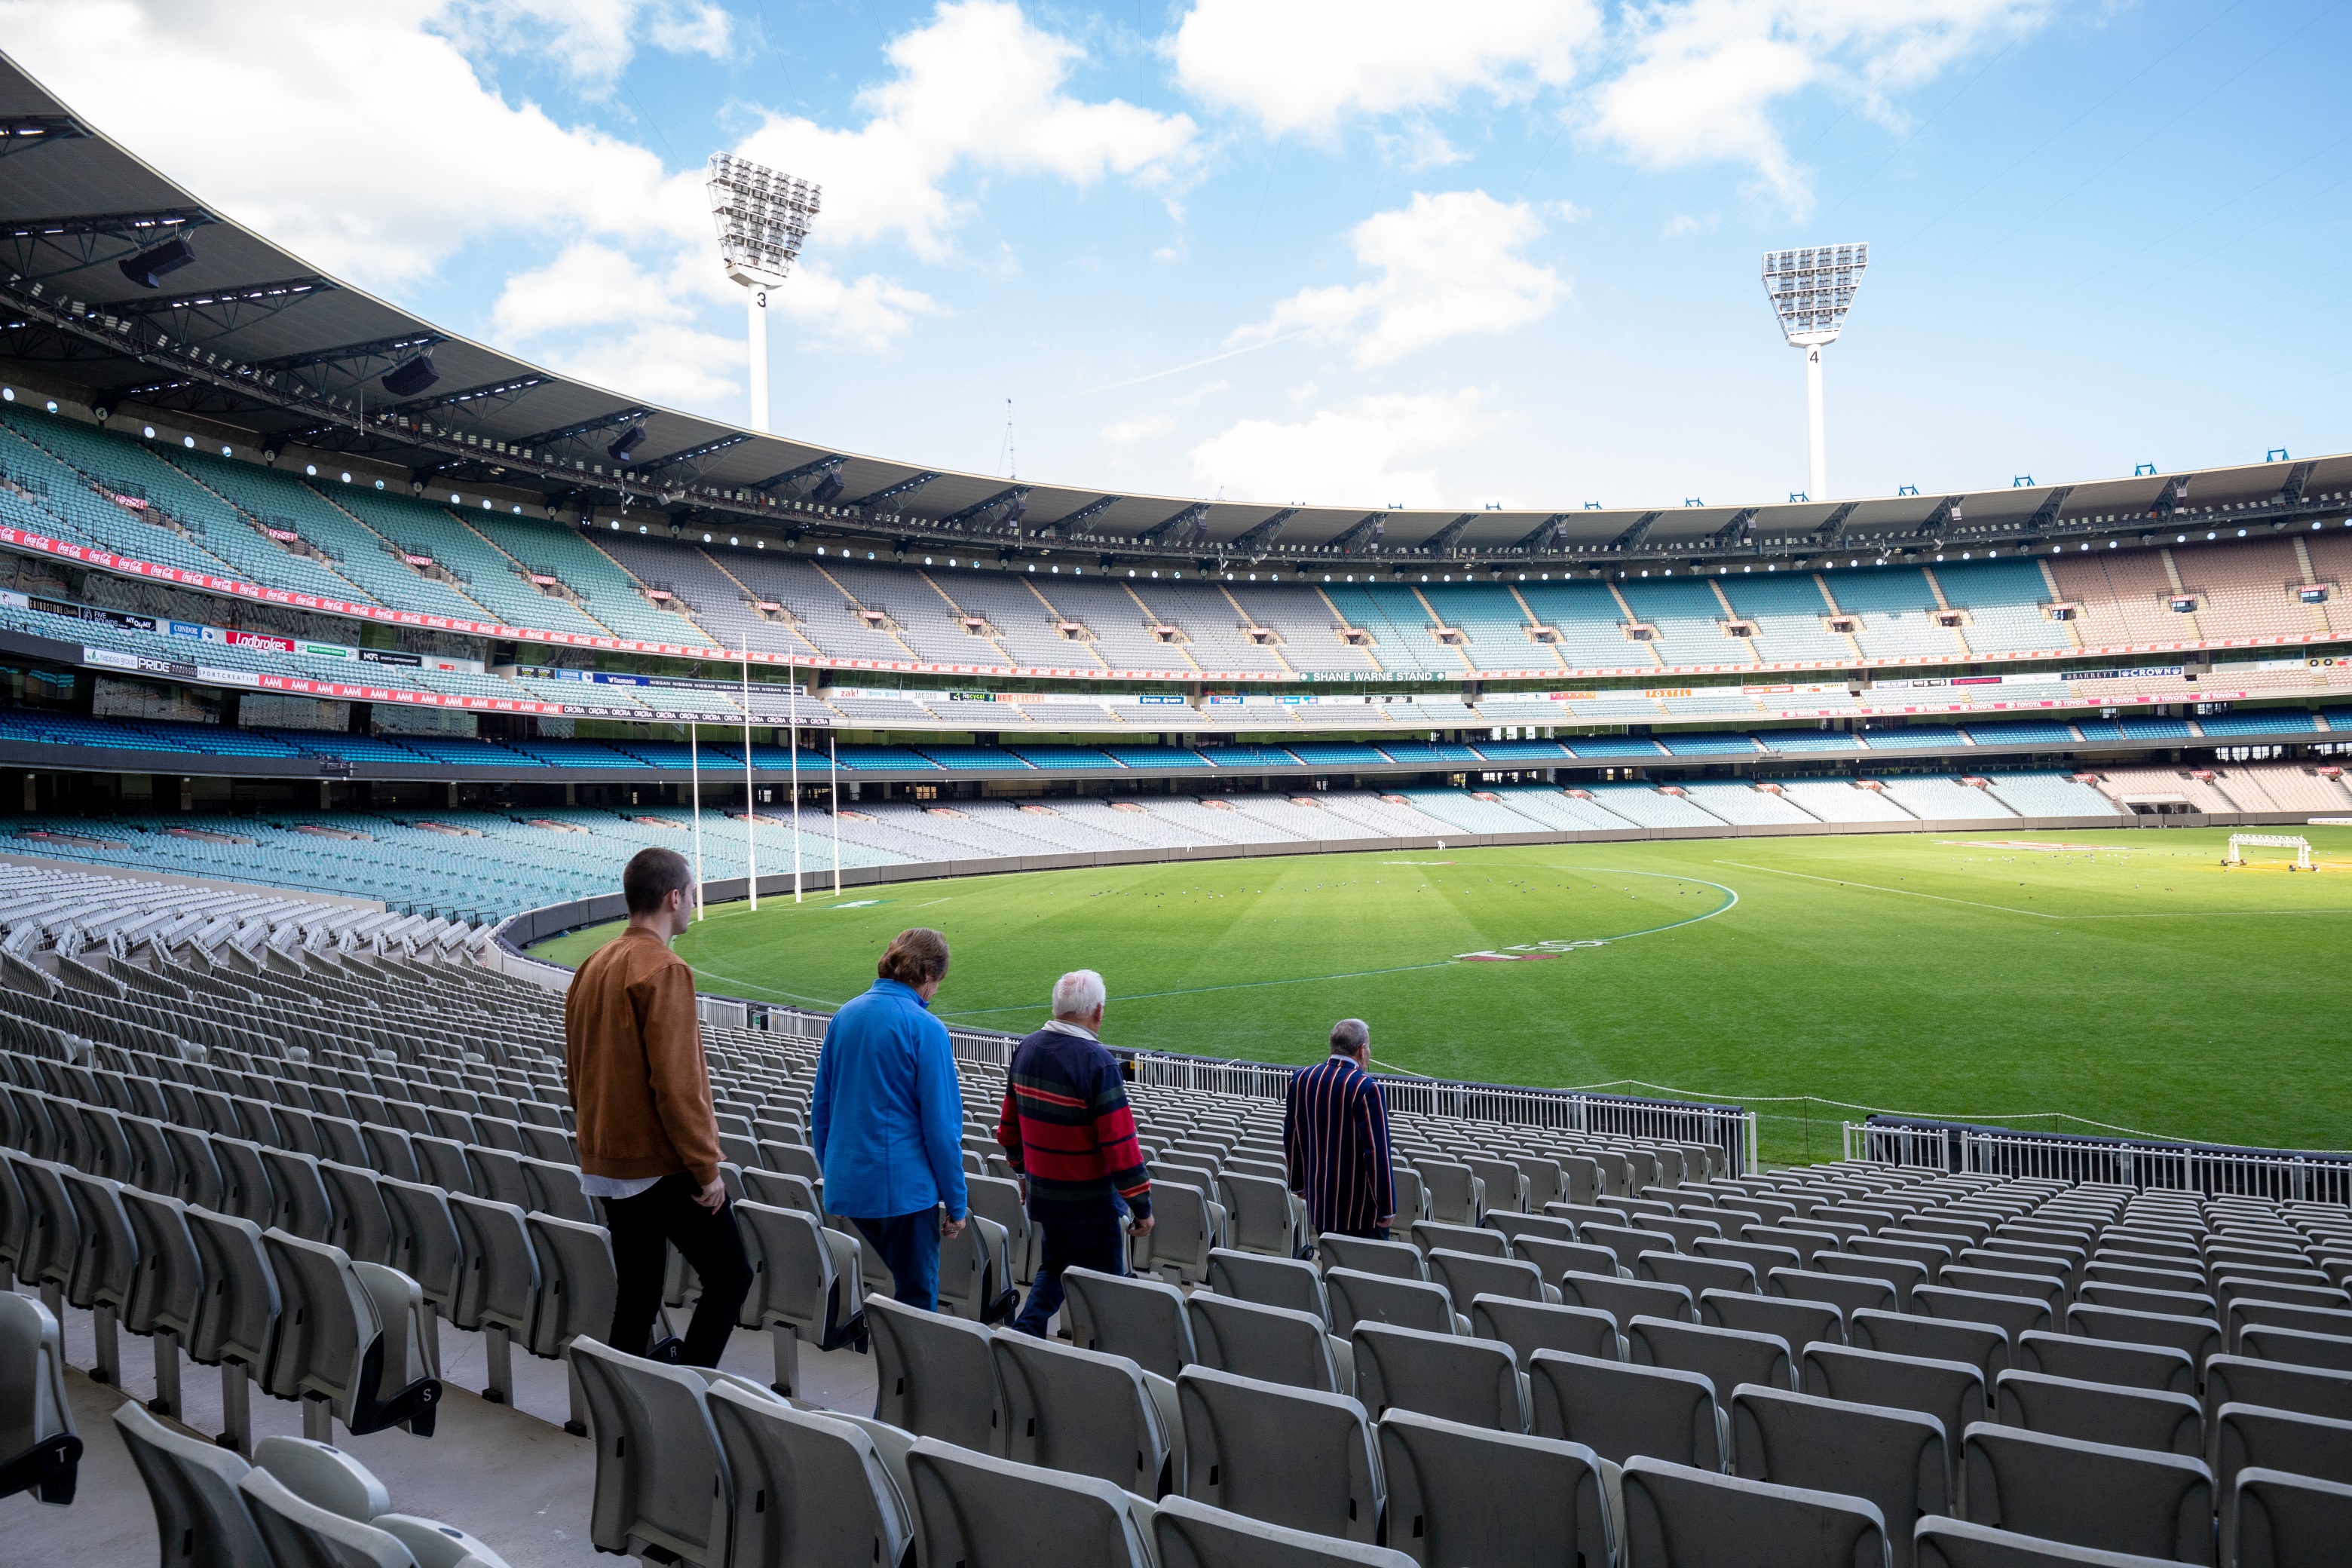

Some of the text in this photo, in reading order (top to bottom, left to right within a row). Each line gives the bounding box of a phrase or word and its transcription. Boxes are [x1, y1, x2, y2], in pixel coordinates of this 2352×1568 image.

[757, 292, 766, 308] 3
[1809, 351, 1819, 363] 4
[174, 624, 198, 635] CONDOR
[236, 633, 286, 651] Ladbrokes
[100, 654, 136, 666] happsa group
[138, 657, 170, 672] PRIDE
[1313, 672, 1432, 681] SHANE WARNE STAND
[2072, 671, 2114, 679] BARRETT
[2130, 668, 2171, 676] CROWN
[264, 677, 559, 713] AAMI AAMI AAMI AAMI AAMI AAMI AAMI AAMI AAMI AAMI AAMI AAMI
[841, 689, 859, 697] zak!
[565, 706, 585, 714] ORORA
[588, 707, 608, 715] ORORA
[634, 709, 653, 718] ORORA
[656, 711, 676, 719] ORORA
[1011, 1295, 1016, 1305] P
[670, 1346, 677, 1358] R
[423, 1388, 432, 1402] S
[55, 1446, 67, 1463] T
